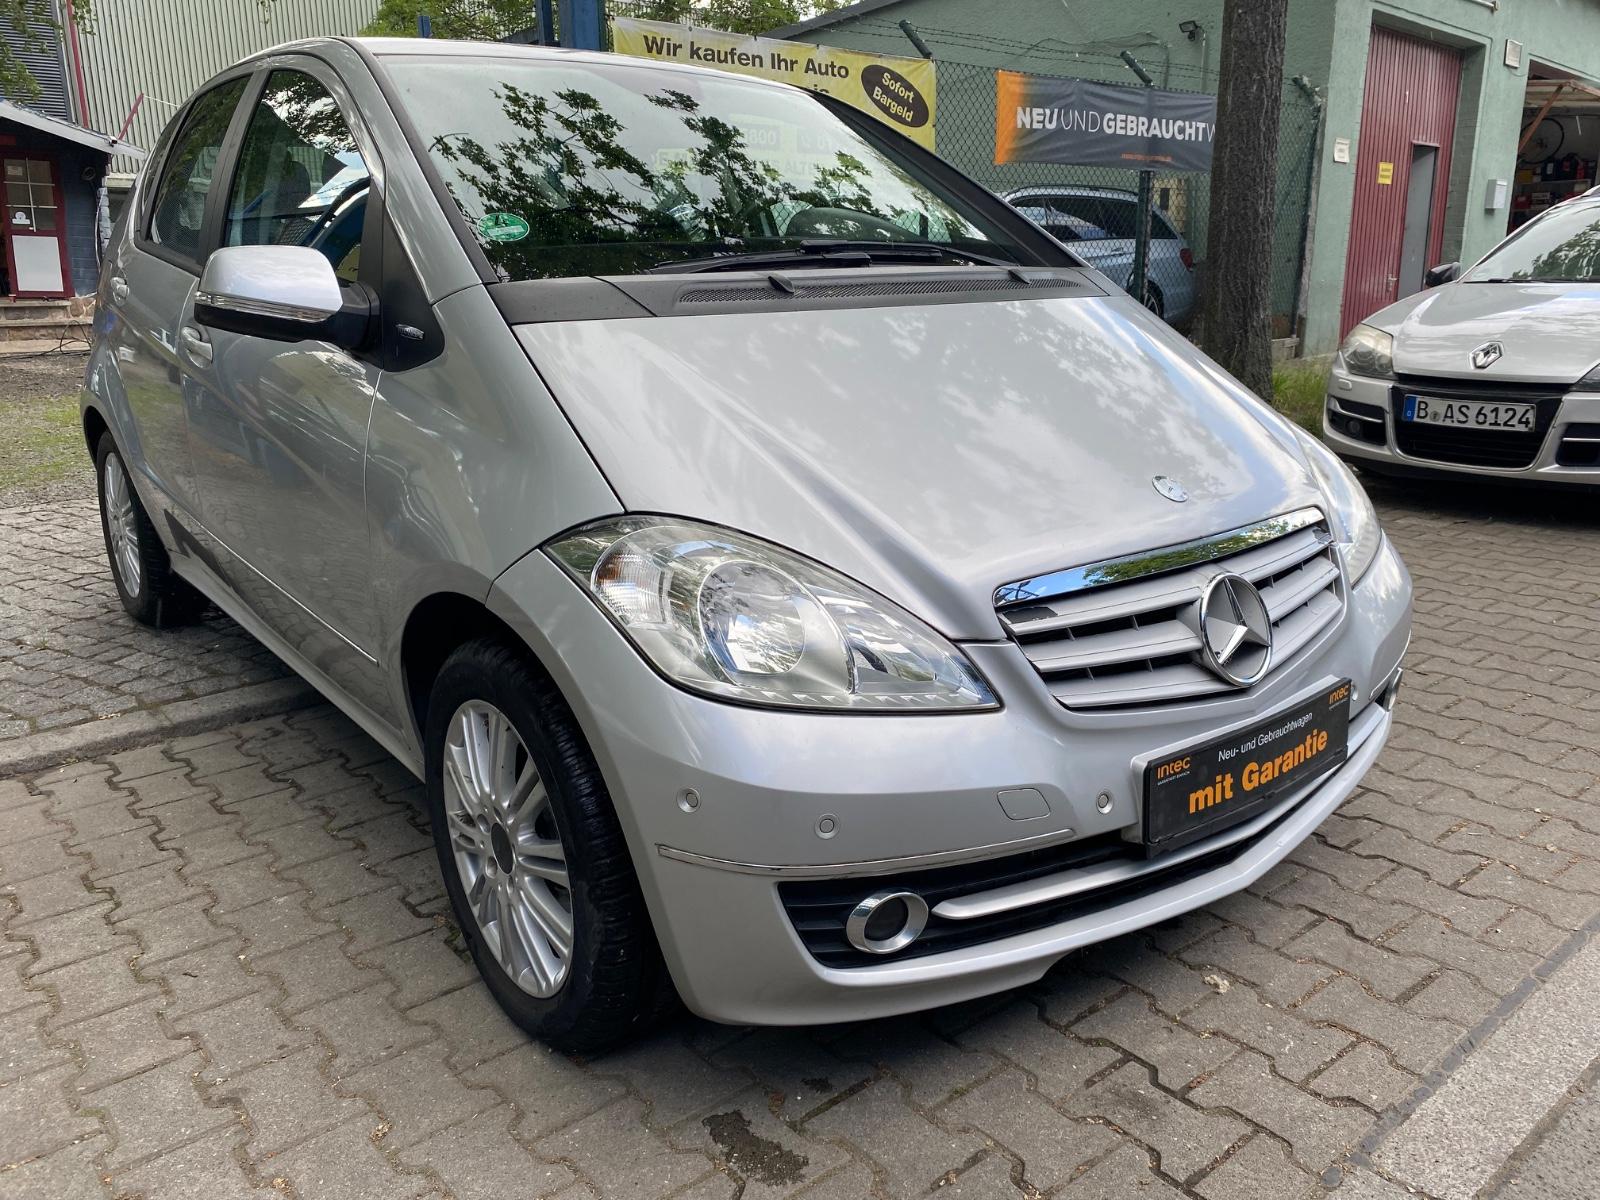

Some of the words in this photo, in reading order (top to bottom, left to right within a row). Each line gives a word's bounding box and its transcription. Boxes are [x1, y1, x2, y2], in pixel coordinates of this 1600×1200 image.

[643, 35, 682, 57] Wir
[689, 41, 764, 68] kaufen
[771, 53, 798, 72] Ihr
[804, 57, 850, 79] Auto
[872, 86, 914, 122] Bargeld
[882, 72, 914, 103] Sofort
[1218, 747, 1240, 762] Neu-
[1240, 738, 1256, 753] und
[1257, 712, 1313, 746] Gebrauchtwagen
[1157, 757, 1190, 780] intec
[1189, 772, 1234, 815] mit
[1241, 729, 1328, 792] Garantie
